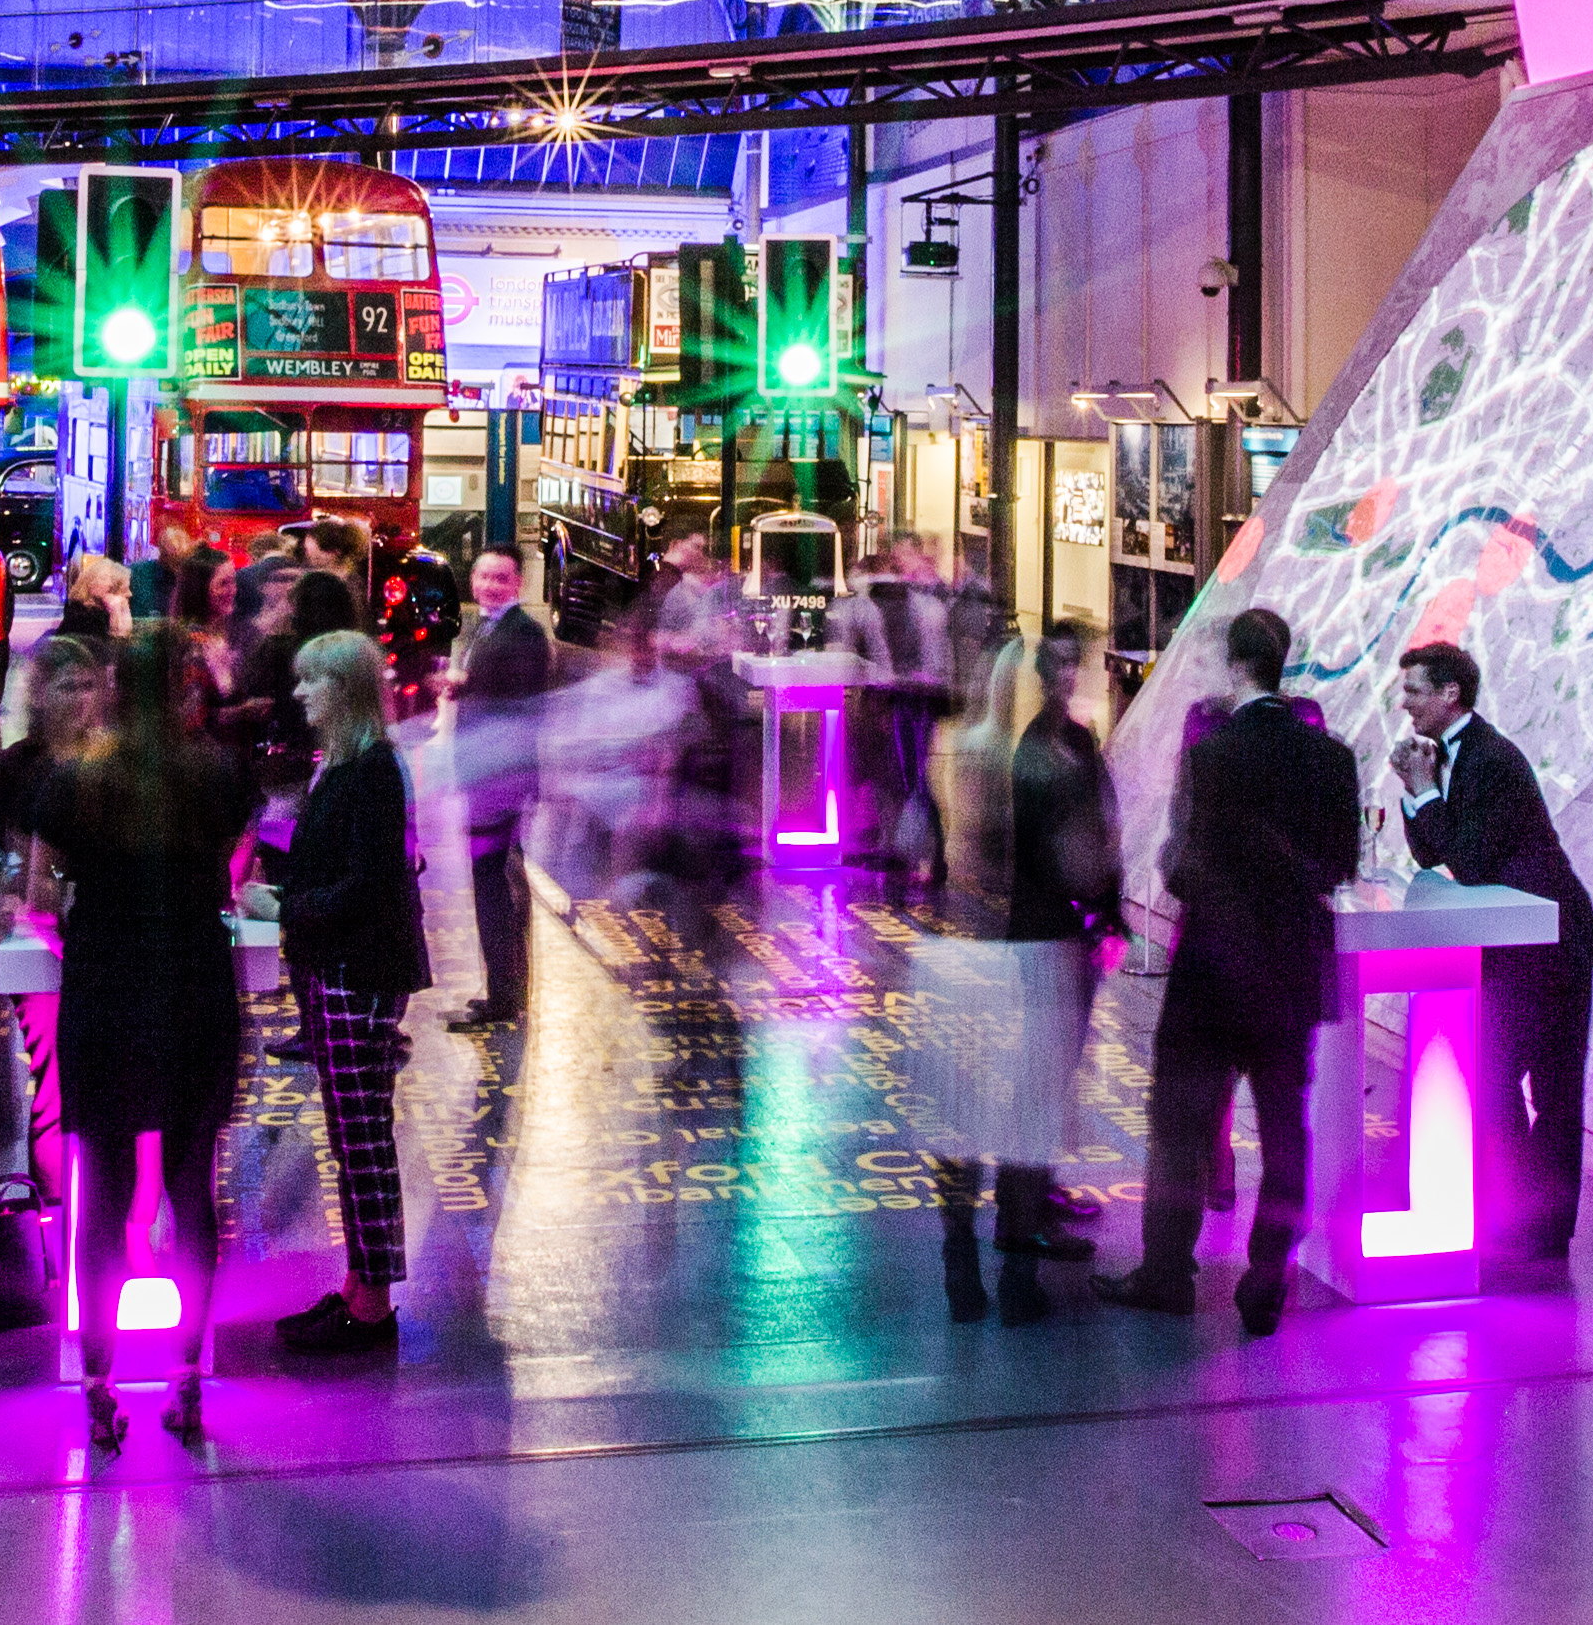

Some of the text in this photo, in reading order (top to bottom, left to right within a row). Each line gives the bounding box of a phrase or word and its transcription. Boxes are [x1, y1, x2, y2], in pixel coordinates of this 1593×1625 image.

[195, 320, 236, 347] FAIR
[362, 306, 389, 334] 92
[266, 359, 354, 376] WEMBLEY
[418, 1123, 490, 1213] Holborn
